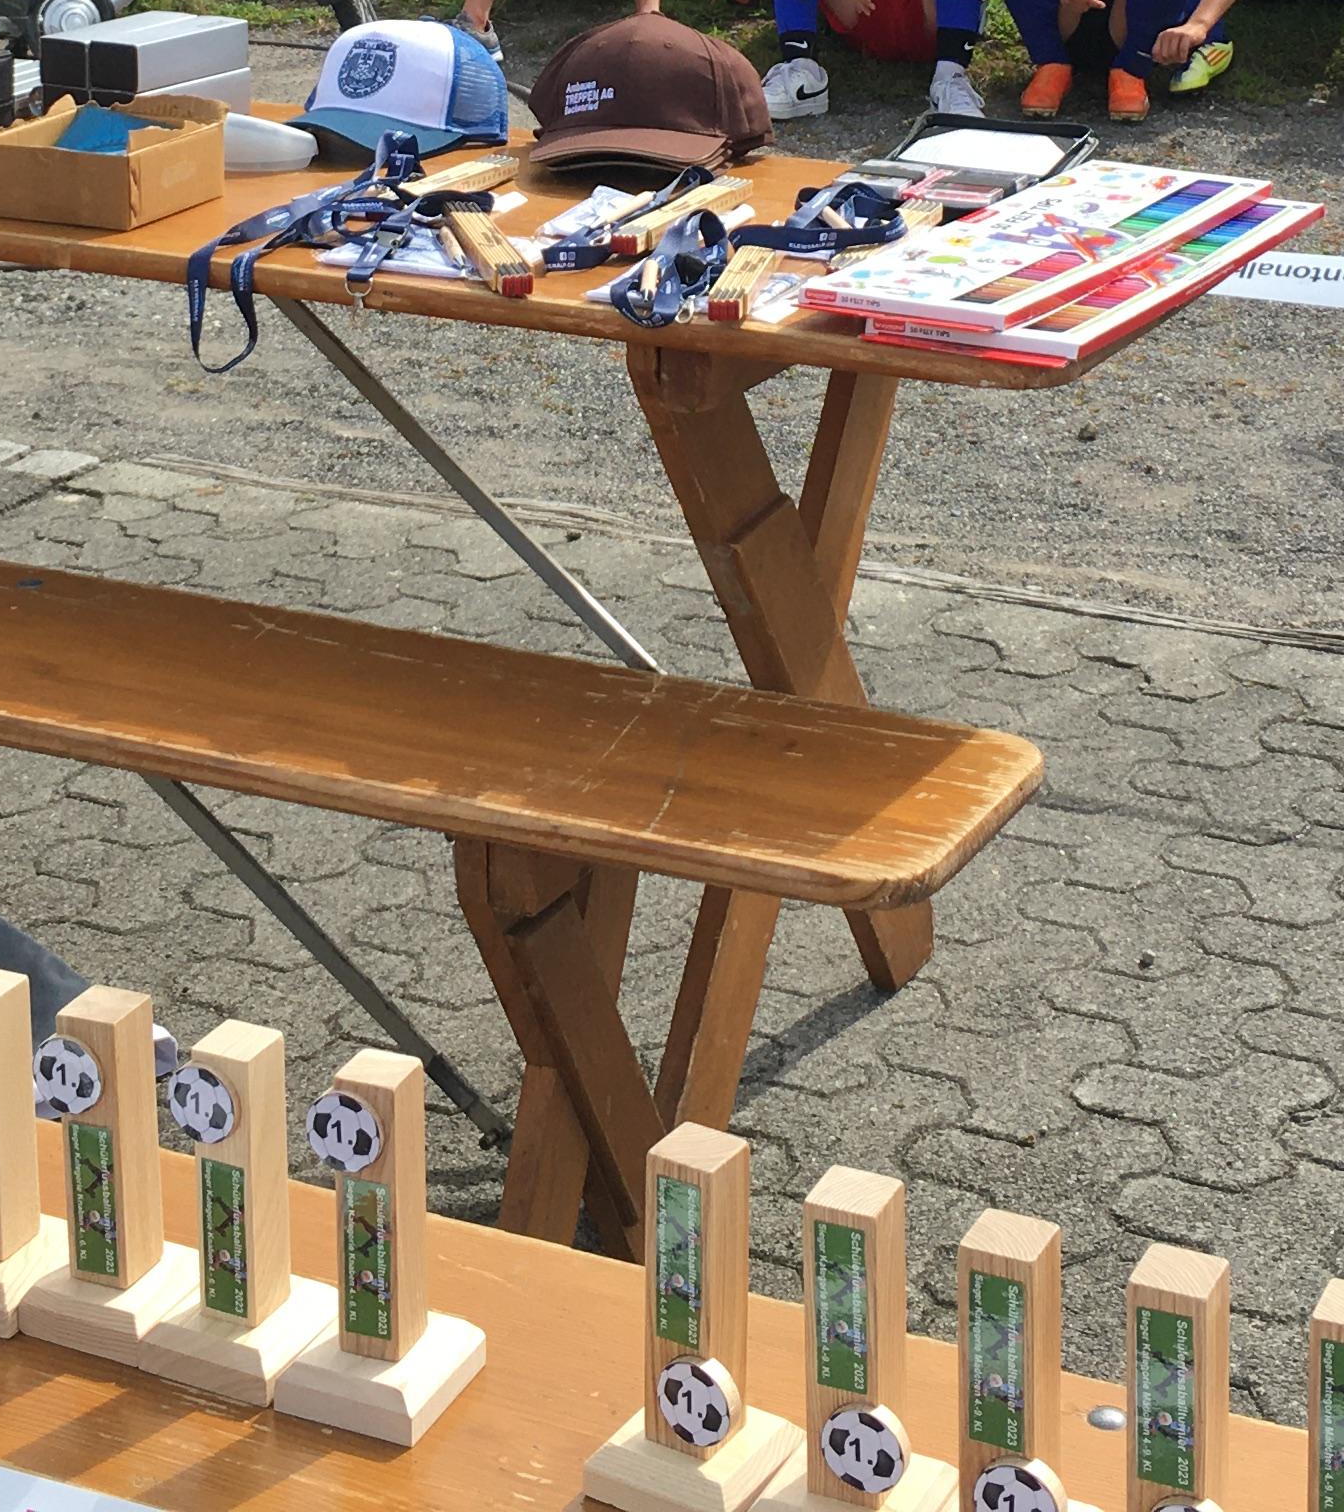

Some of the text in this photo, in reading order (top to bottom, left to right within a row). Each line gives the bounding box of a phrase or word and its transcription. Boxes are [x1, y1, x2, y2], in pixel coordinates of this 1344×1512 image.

[564, 88, 614, 106] TREPPEN AG
[56, 1063, 77, 1088] 1.
[190, 1092, 209, 1118] 1.
[330, 1119, 353, 1146] 1.
[105, 1248, 115, 1273] 2023
[234, 1288, 244, 1313] 2023
[378, 1309, 388, 1335] 2023
[688, 1317, 698, 1344] 2023
[1324, 1342, 1335, 1374] Sieger
[854, 1362, 864, 1390] 2023
[681, 1389, 703, 1418] 1.
[1323, 1376, 1334, 1423] Kategorie
[1007, 1418, 1018, 1446] 2023
[849, 1437, 873, 1465] 1.
[1177, 1457, 1188, 1486] 2023
